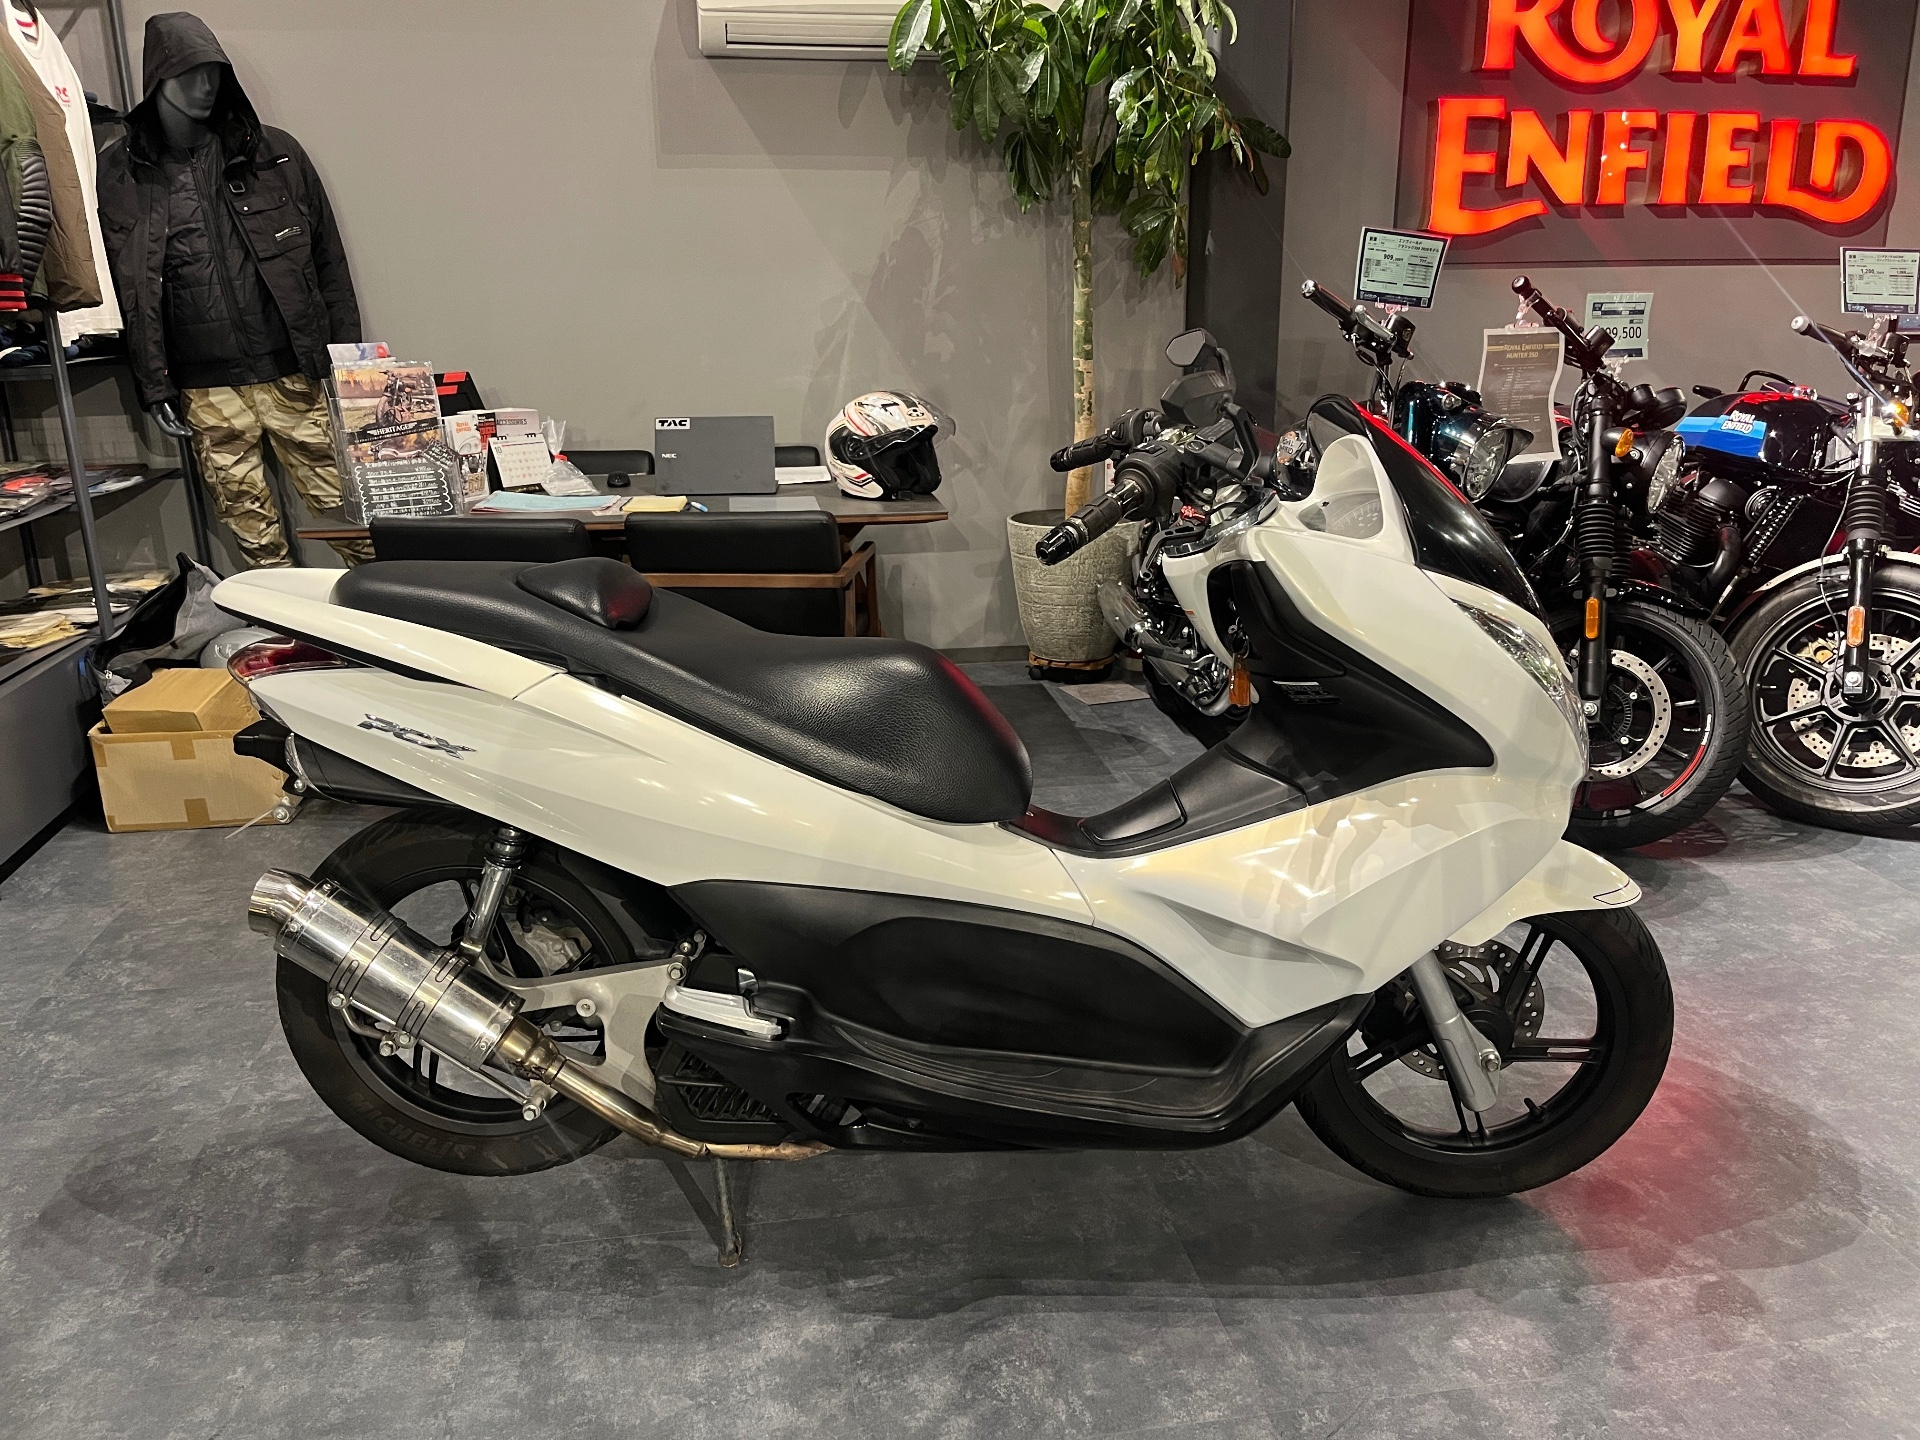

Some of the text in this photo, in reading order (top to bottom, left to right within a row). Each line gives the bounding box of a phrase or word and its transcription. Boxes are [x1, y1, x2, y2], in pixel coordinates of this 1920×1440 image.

[1482, 0, 1857, 83] ROYAL
[1427, 96, 1892, 235] ENFIELD
[1729, 410, 1756, 423] ROYAL
[377, 423, 411, 435] HERITAGE
[658, 419, 688, 427] TAC
[1721, 421, 1753, 433] ENFIELD
